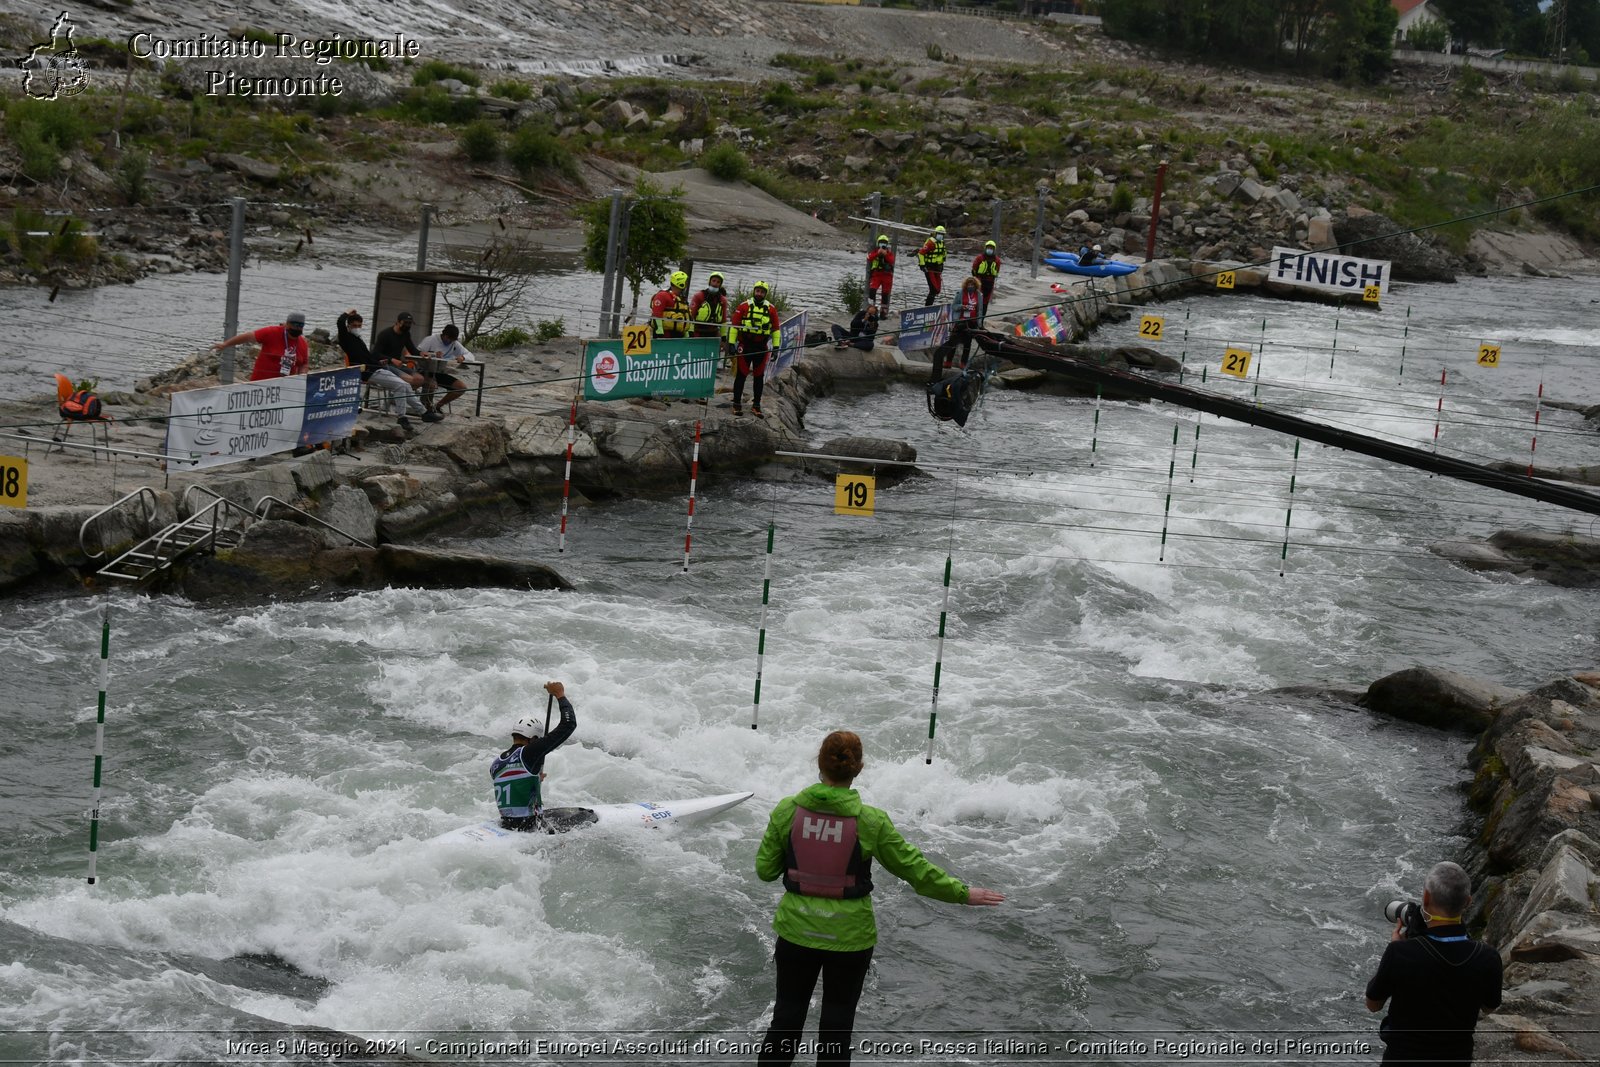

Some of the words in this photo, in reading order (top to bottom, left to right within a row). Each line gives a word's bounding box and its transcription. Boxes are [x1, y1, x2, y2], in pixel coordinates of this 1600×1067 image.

[1220, 274, 1232, 285] 24
[1278, 252, 1383, 289] FINISH
[1366, 288, 1378, 299] 25
[1142, 321, 1160, 336] 22
[627, 331, 647, 349] 20
[1226, 354, 1247, 373] 21
[1481, 348, 1497, 363] 23
[625, 353, 670, 388] Raspini
[672, 351, 714, 380] Salumi
[318, 376, 336, 391] ECA
[227, 388, 264, 410] ISTITUTO
[265, 386, 281, 404] PER
[196, 406, 213, 425] ICS
[239, 412, 246, 430] IL
[248, 408, 284, 429] CREDITO
[228, 431, 269, 455] SPORTIVO
[0, 465, 20, 498] 18
[844, 482, 868, 507] 19
[494, 783, 512, 806] 21
[802, 816, 844, 843] HH
